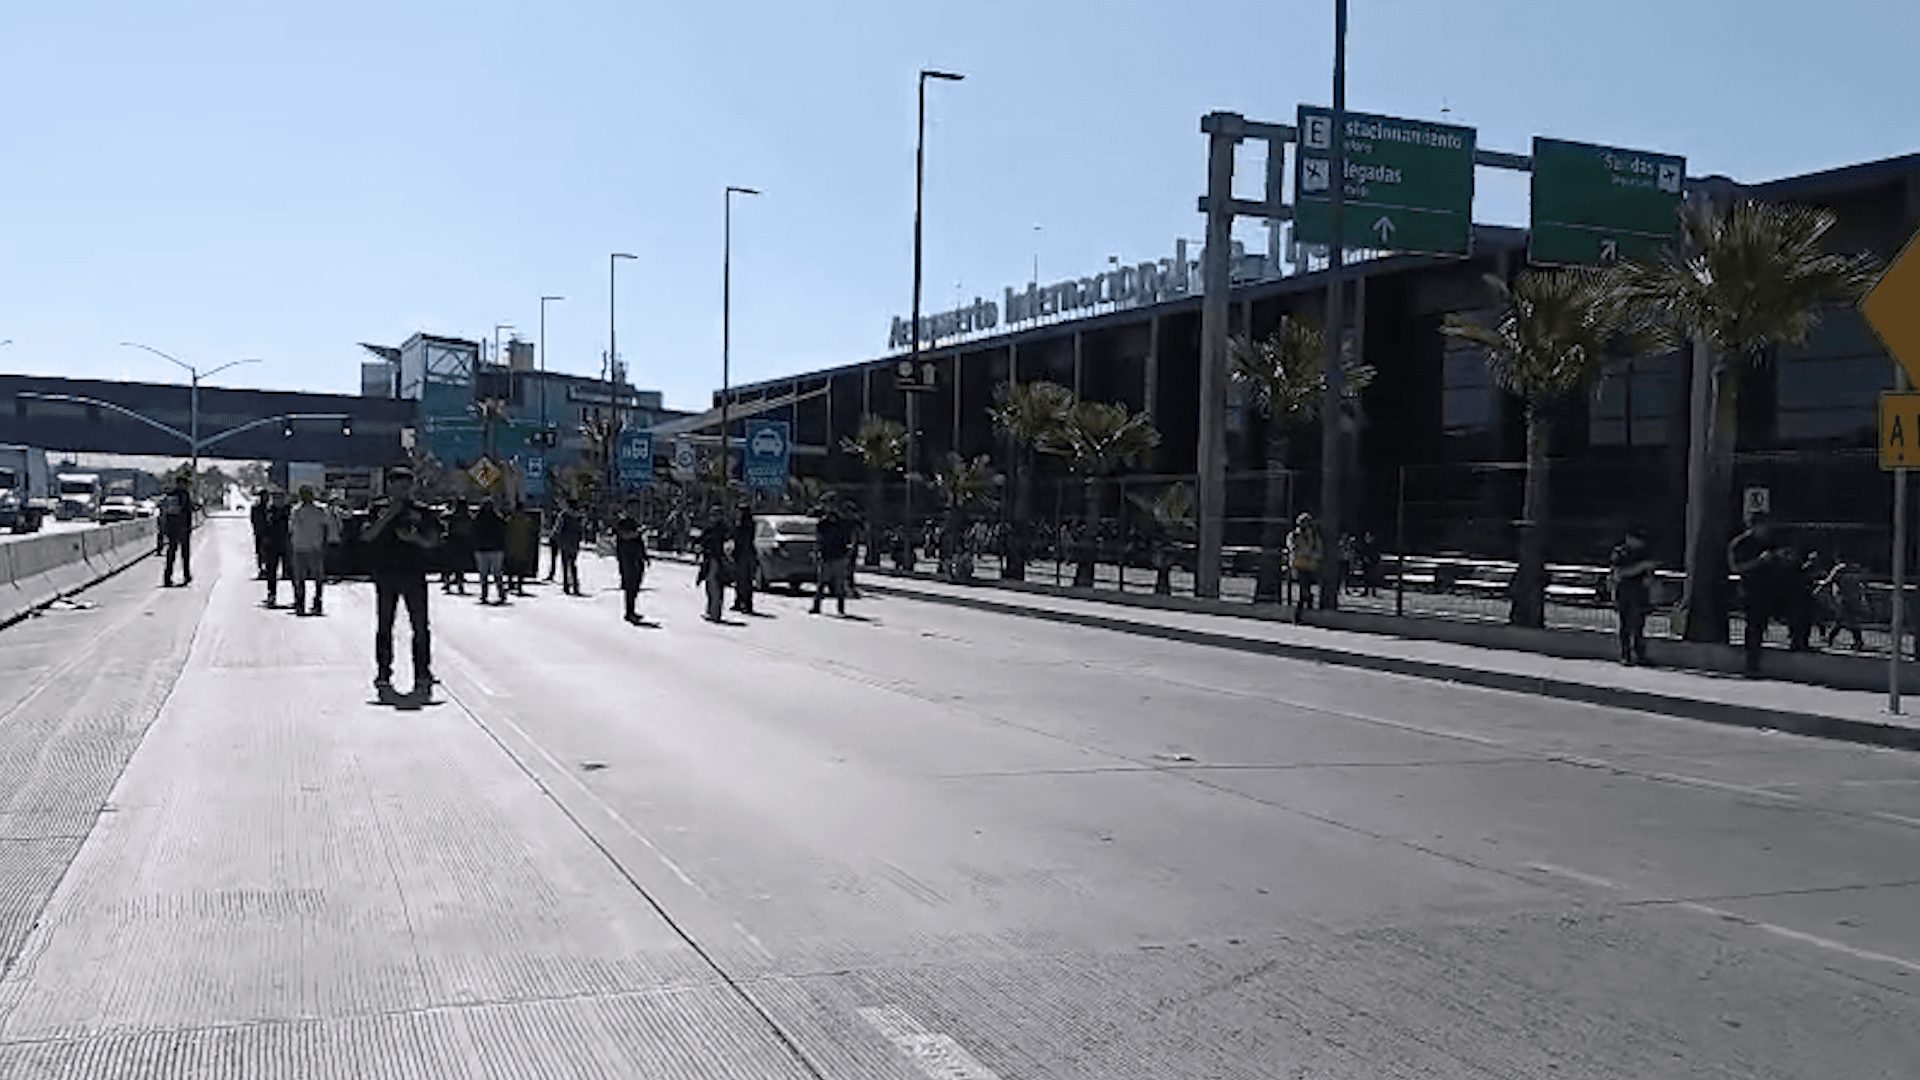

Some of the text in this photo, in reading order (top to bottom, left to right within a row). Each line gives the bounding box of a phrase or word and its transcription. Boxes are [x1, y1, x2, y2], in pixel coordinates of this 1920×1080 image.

[1311, 121, 1324, 143] E
[1344, 119, 1463, 150] stacionamiento
[1342, 157, 1403, 185] legadas
[888, 296, 999, 349] Aeopuerto
[1005, 238, 1189, 323] Internacional
